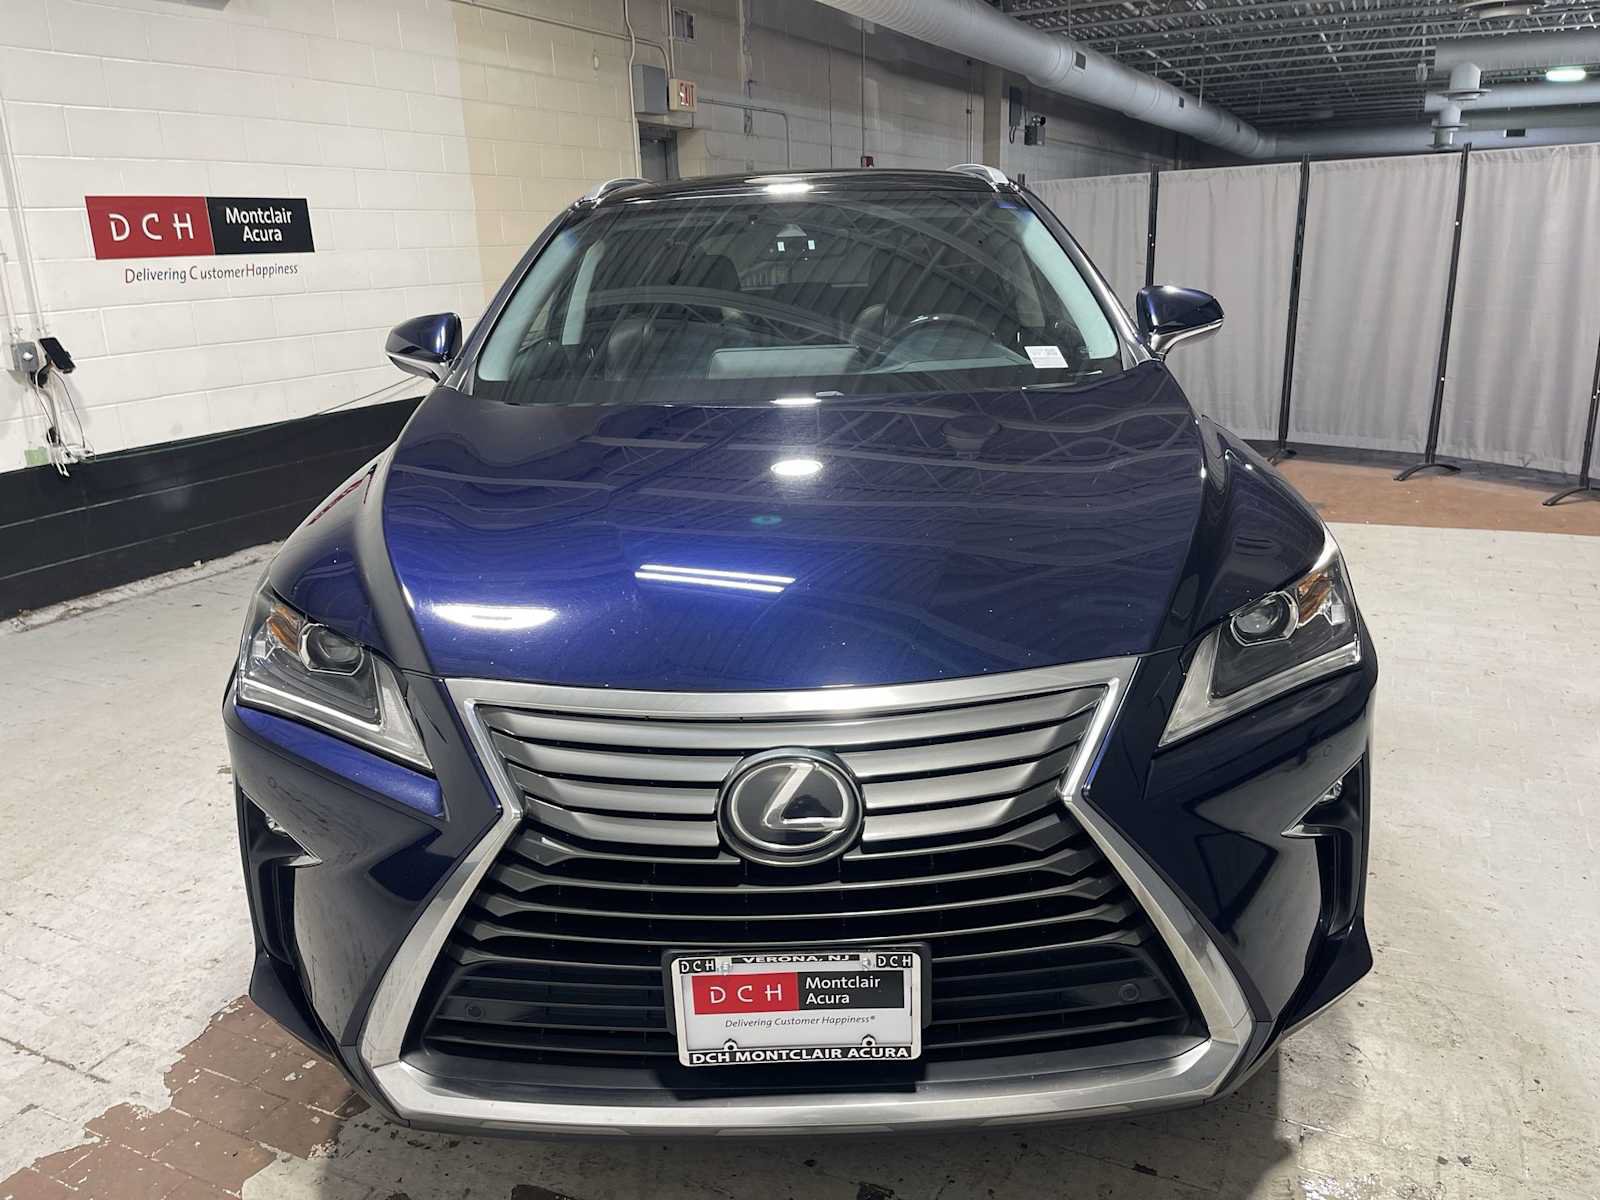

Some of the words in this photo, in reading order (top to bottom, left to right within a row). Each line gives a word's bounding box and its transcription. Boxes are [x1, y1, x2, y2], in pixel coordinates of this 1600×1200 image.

[225, 206, 293, 225] Montclair
[108, 213, 195, 242] DCH
[242, 226, 283, 242] Acura
[125, 267, 187, 284] Delivering
[246, 263, 298, 279] Happiness
[742, 954, 824, 964] VERONA,
[827, 953, 851, 962] NJ
[877, 954, 913, 968] DCH
[680, 960, 716, 974] DCH
[805, 975, 881, 990] Montclair
[709, 983, 782, 1004] DCH
[805, 991, 850, 1005] Acura
[725, 1017, 773, 1029] Delivering
[774, 1016, 819, 1026] Customer
[692, 1052, 730, 1065] DCH
[735, 1048, 842, 1063] MONTCLAIR
[847, 1046, 910, 1060] ACURA
